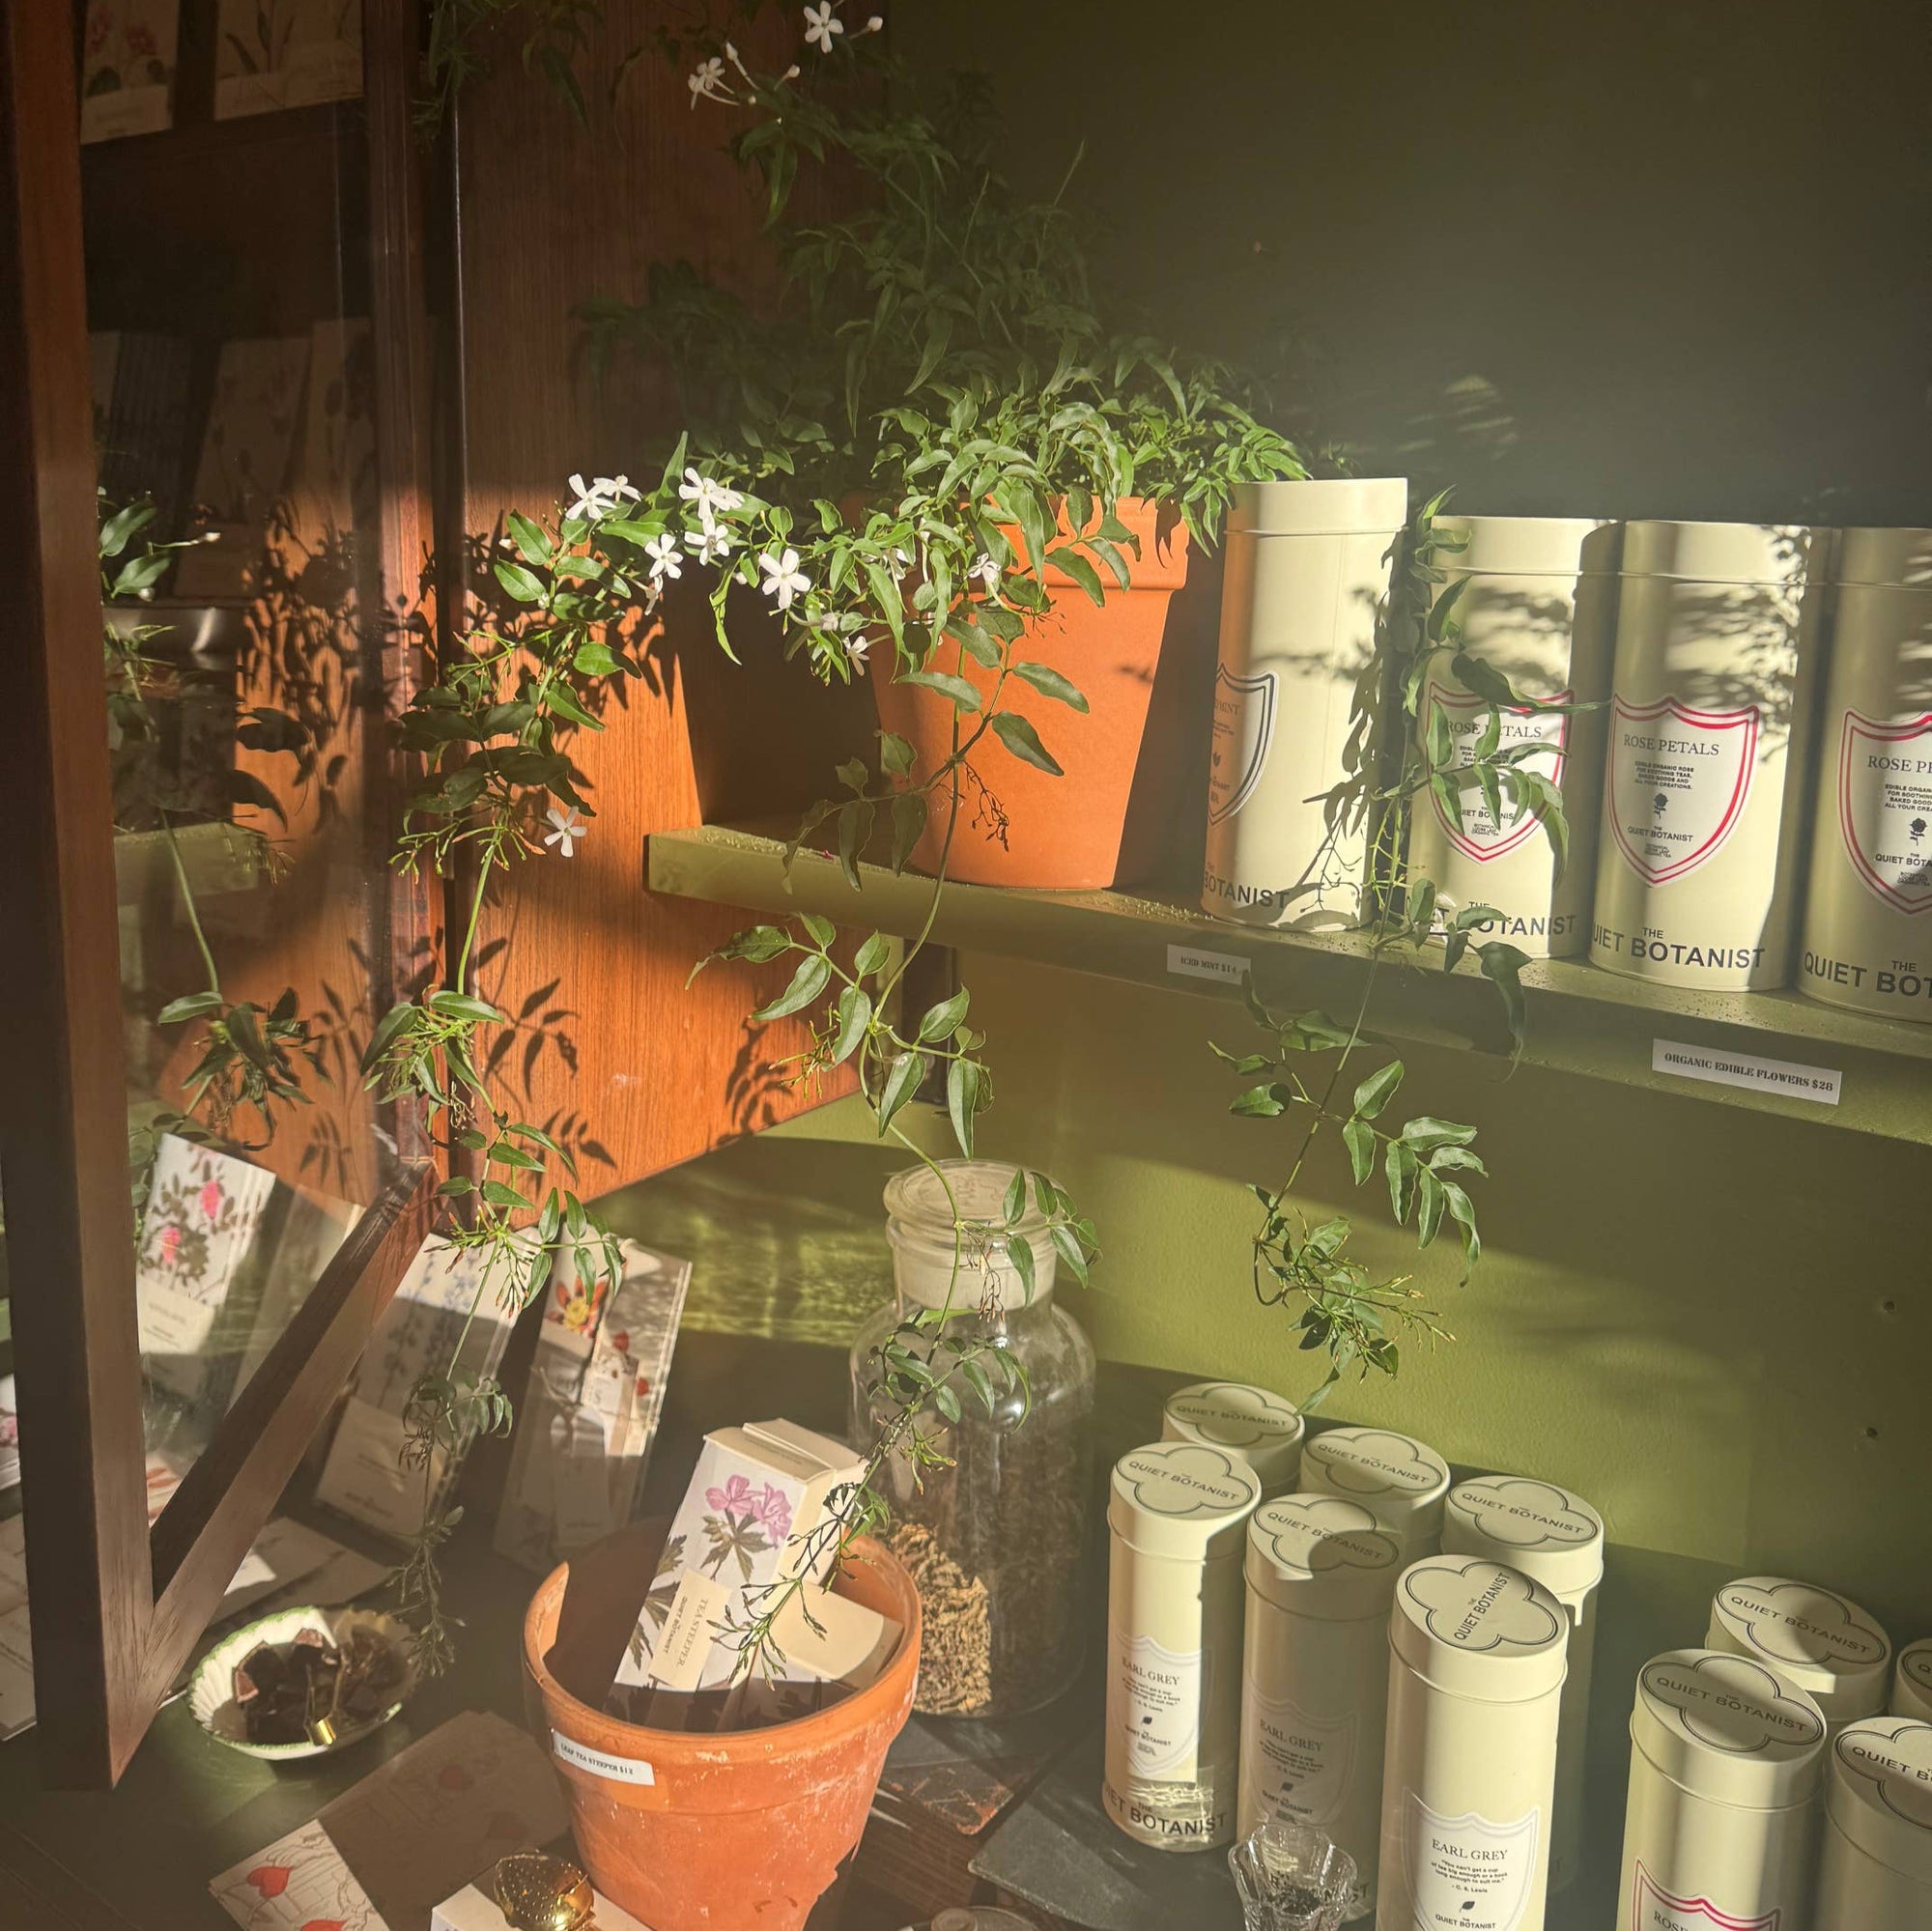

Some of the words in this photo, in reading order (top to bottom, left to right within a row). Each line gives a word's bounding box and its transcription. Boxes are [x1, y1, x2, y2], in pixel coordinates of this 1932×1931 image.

[1624, 734, 1655, 751] ROSE
[1658, 739, 1719, 756] PETALS
[1867, 755, 1912, 773] ROSE
[1650, 830, 1693, 842] BOTANIST
[1875, 853, 1904, 865] QUIET
[1594, 922, 1625, 952] UIET
[1631, 937, 1766, 969] BOTANIST
[1642, 926, 1664, 940] THE
[1804, 951, 1868, 988] QUIET
[1890, 960, 1918, 973] THE
[1664, 1052, 1713, 1069] ORGANIC
[1715, 1062, 1754, 1077] EDIBLE
[1756, 1069, 1809, 1088] FLOWERS
[1811, 1078, 1833, 1093] $28
[1177, 1405, 1216, 1418] QUIET
[1220, 1411, 1289, 1428] BOTANIST
[1318, 1443, 1358, 1461] QUIET
[1360, 1458, 1431, 1484] BOTANIST
[1128, 1461, 1170, 1478] QUIET
[1170, 1474, 1240, 1500] BOTANIST
[1462, 1492, 1507, 1510] QUIET
[1508, 1507, 1585, 1534] BOTANIST
[1267, 1511, 1312, 1531] QUIET
[1311, 1528, 1385, 1560] BOTANIST
[696, 1599, 708, 1618] TEA
[1453, 1614, 1479, 1641] QUIET
[1474, 1572, 1513, 1615] BOTANIST
[1731, 1596, 1782, 1619] QUIET
[1784, 1616, 1872, 1654] BOTANIST
[676, 1619, 699, 1667] STEEPER
[1122, 1656, 1147, 1679] EARL
[1148, 1671, 1179, 1686] GREY
[1657, 1677, 1712, 1700] QUIET
[1715, 1696, 1809, 1733] BOTANIST
[1260, 1718, 1287, 1743] EARL
[1289, 1735, 1323, 1751] GREY
[560, 1743, 574, 1756] LEAF
[576, 1752, 587, 1763] TEA
[588, 1757, 618, 1773] STEEPER
[619, 1765, 634, 1775] $12
[1852, 1746, 1911, 1774] QUIET
[1130, 1806, 1226, 1835] BOTANIST
[1432, 1838, 1467, 1859] EARL
[1471, 1849, 1508, 1860] GREY
[1435, 1914, 1458, 1926] QUIET
[1459, 1920, 1496, 1930] BOTANIST
